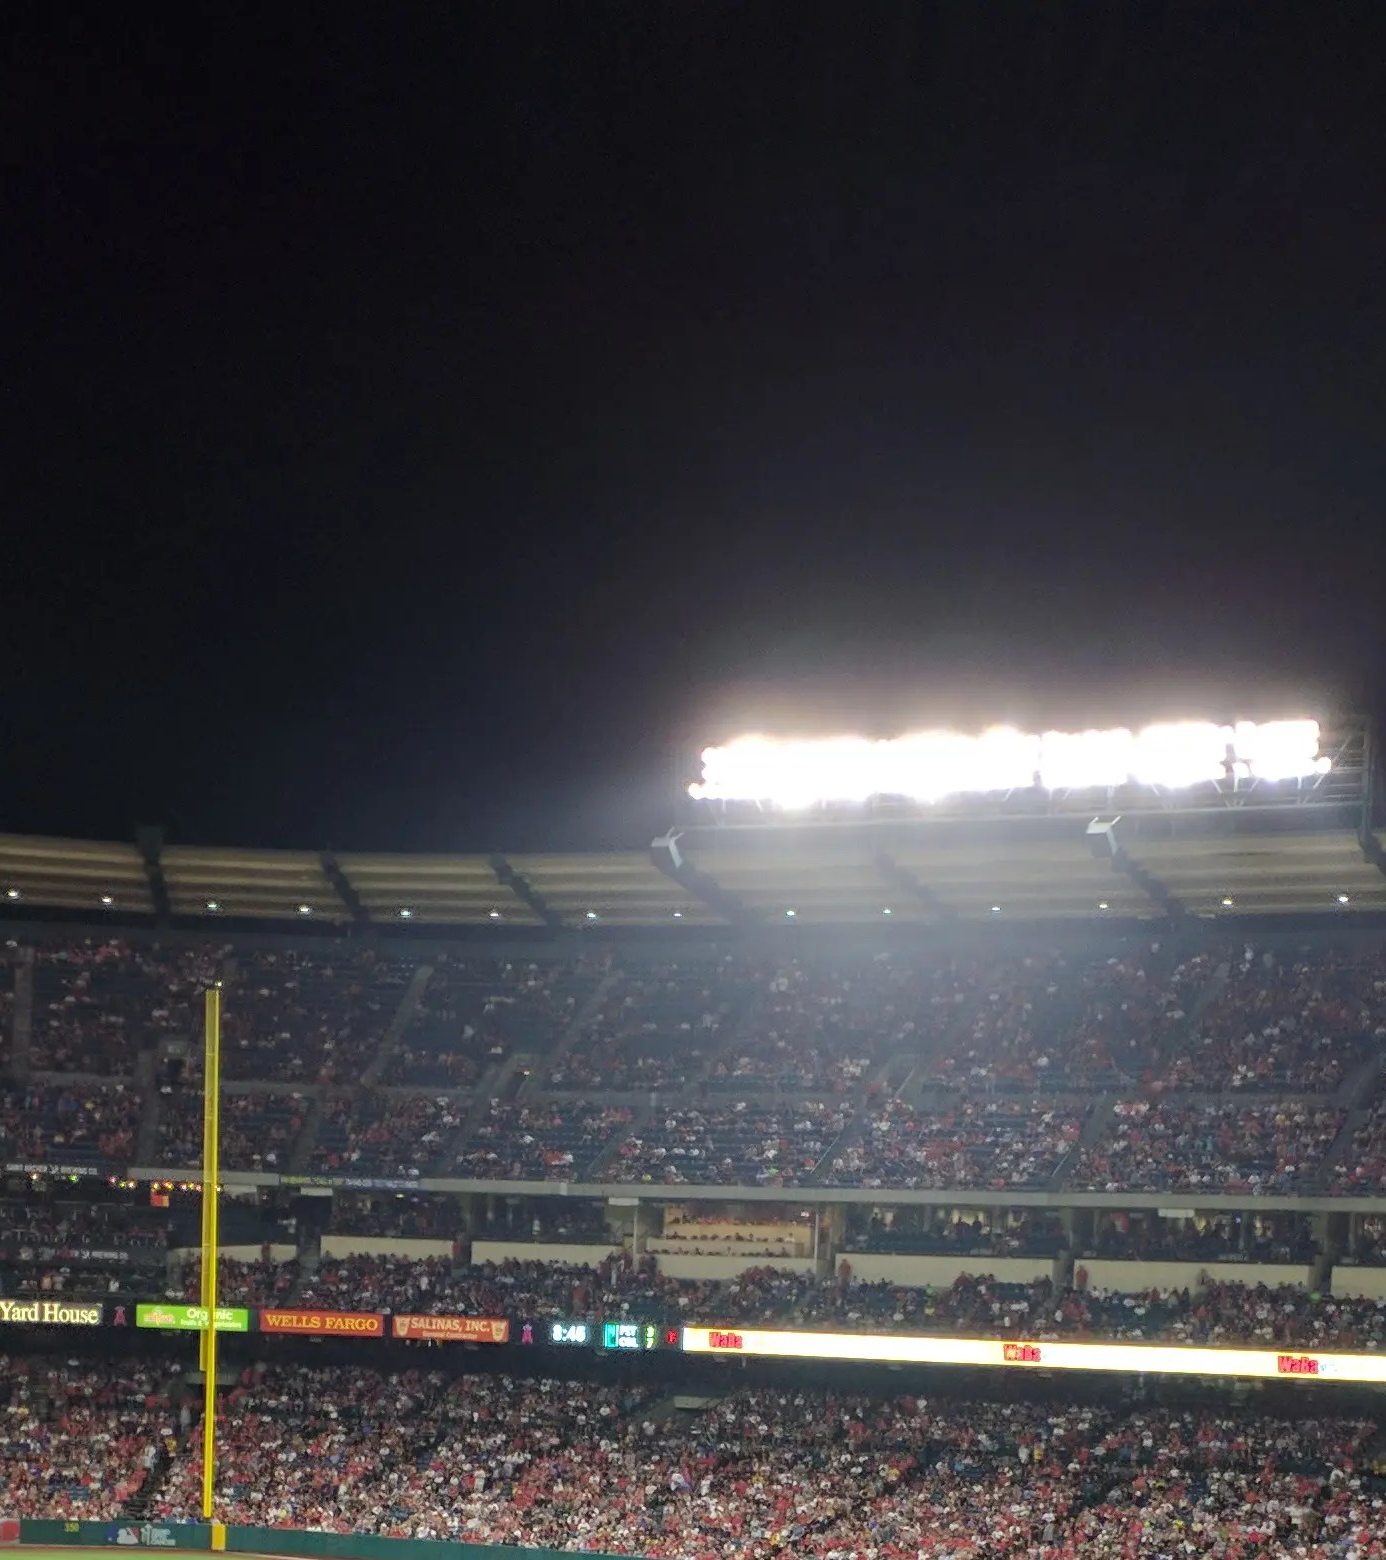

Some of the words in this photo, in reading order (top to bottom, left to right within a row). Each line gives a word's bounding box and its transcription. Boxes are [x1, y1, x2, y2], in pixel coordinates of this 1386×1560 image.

[43, 1302, 99, 1325] House
[186, 1307, 233, 1321] Orgnic
[265, 1313, 321, 1329] WELLS
[324, 1316, 379, 1332] FARGO
[410, 1318, 462, 1332] SALINAS,
[466, 1320, 491, 1333] INC.
[1277, 1356, 1319, 1375] WaBa
